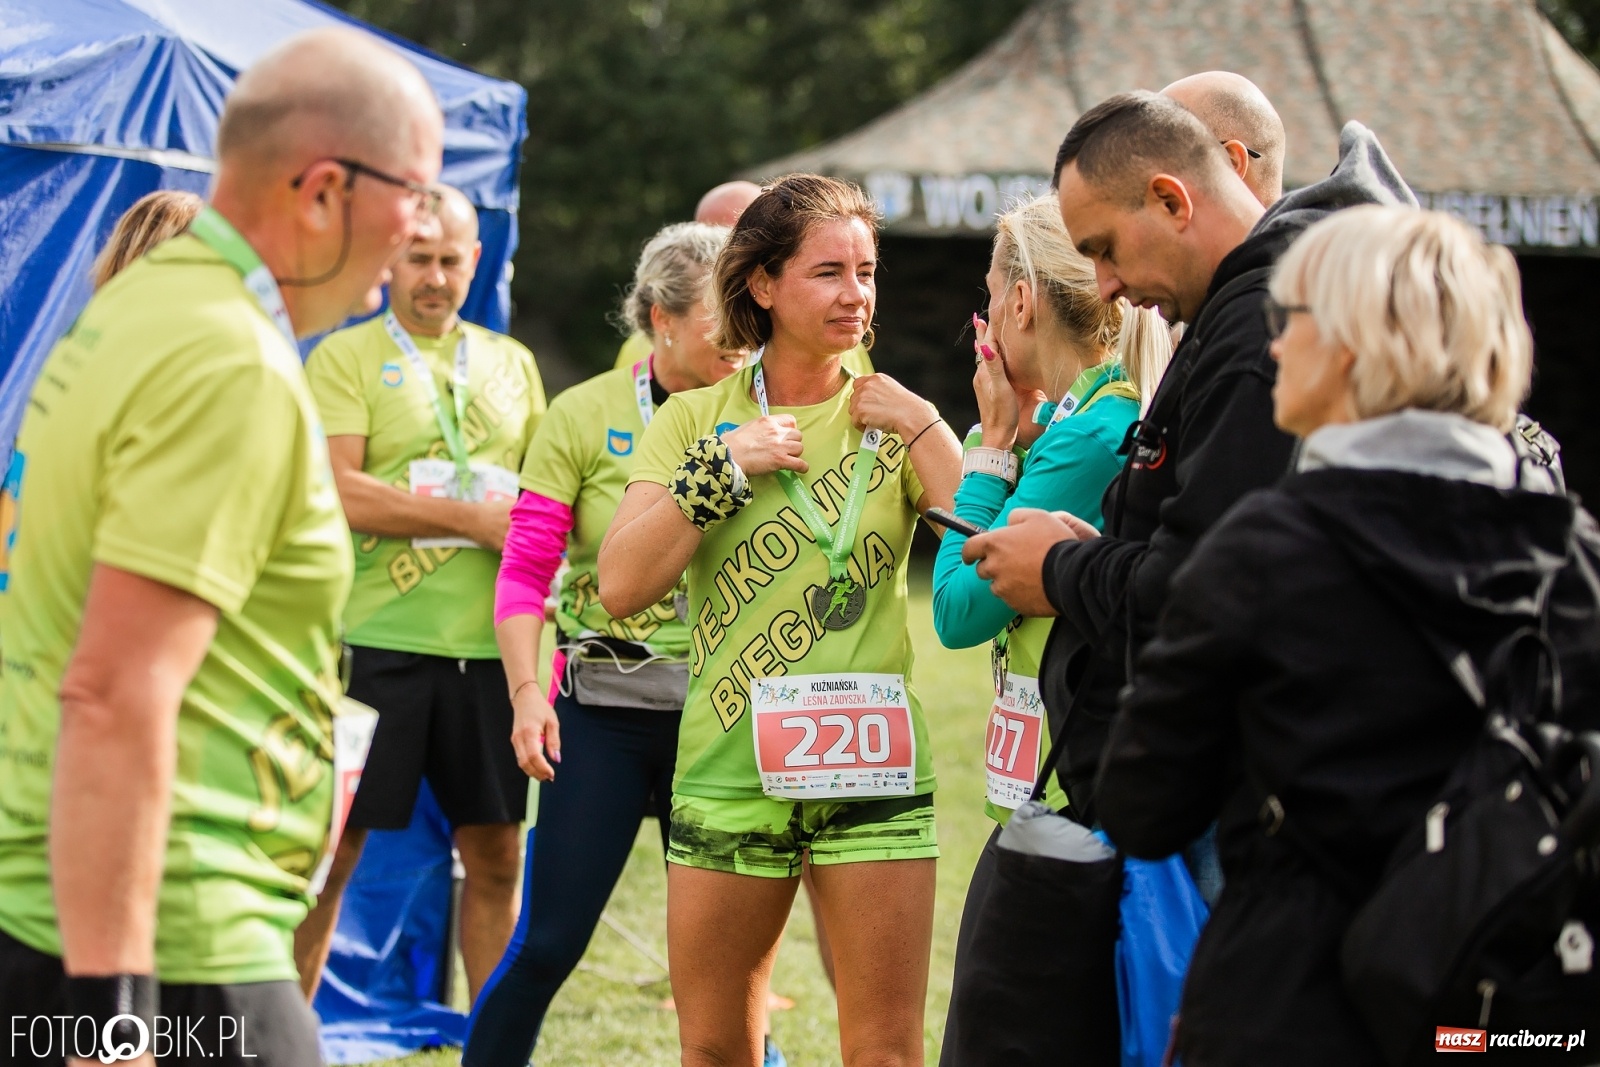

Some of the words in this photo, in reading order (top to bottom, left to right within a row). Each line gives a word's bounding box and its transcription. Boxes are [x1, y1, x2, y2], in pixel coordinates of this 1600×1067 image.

[811, 679, 858, 692] KUŹNIAŃSKA
[803, 694, 828, 706] LEŚNA
[830, 693, 867, 705] ZADYSZKA
[781, 713, 891, 767] 220
